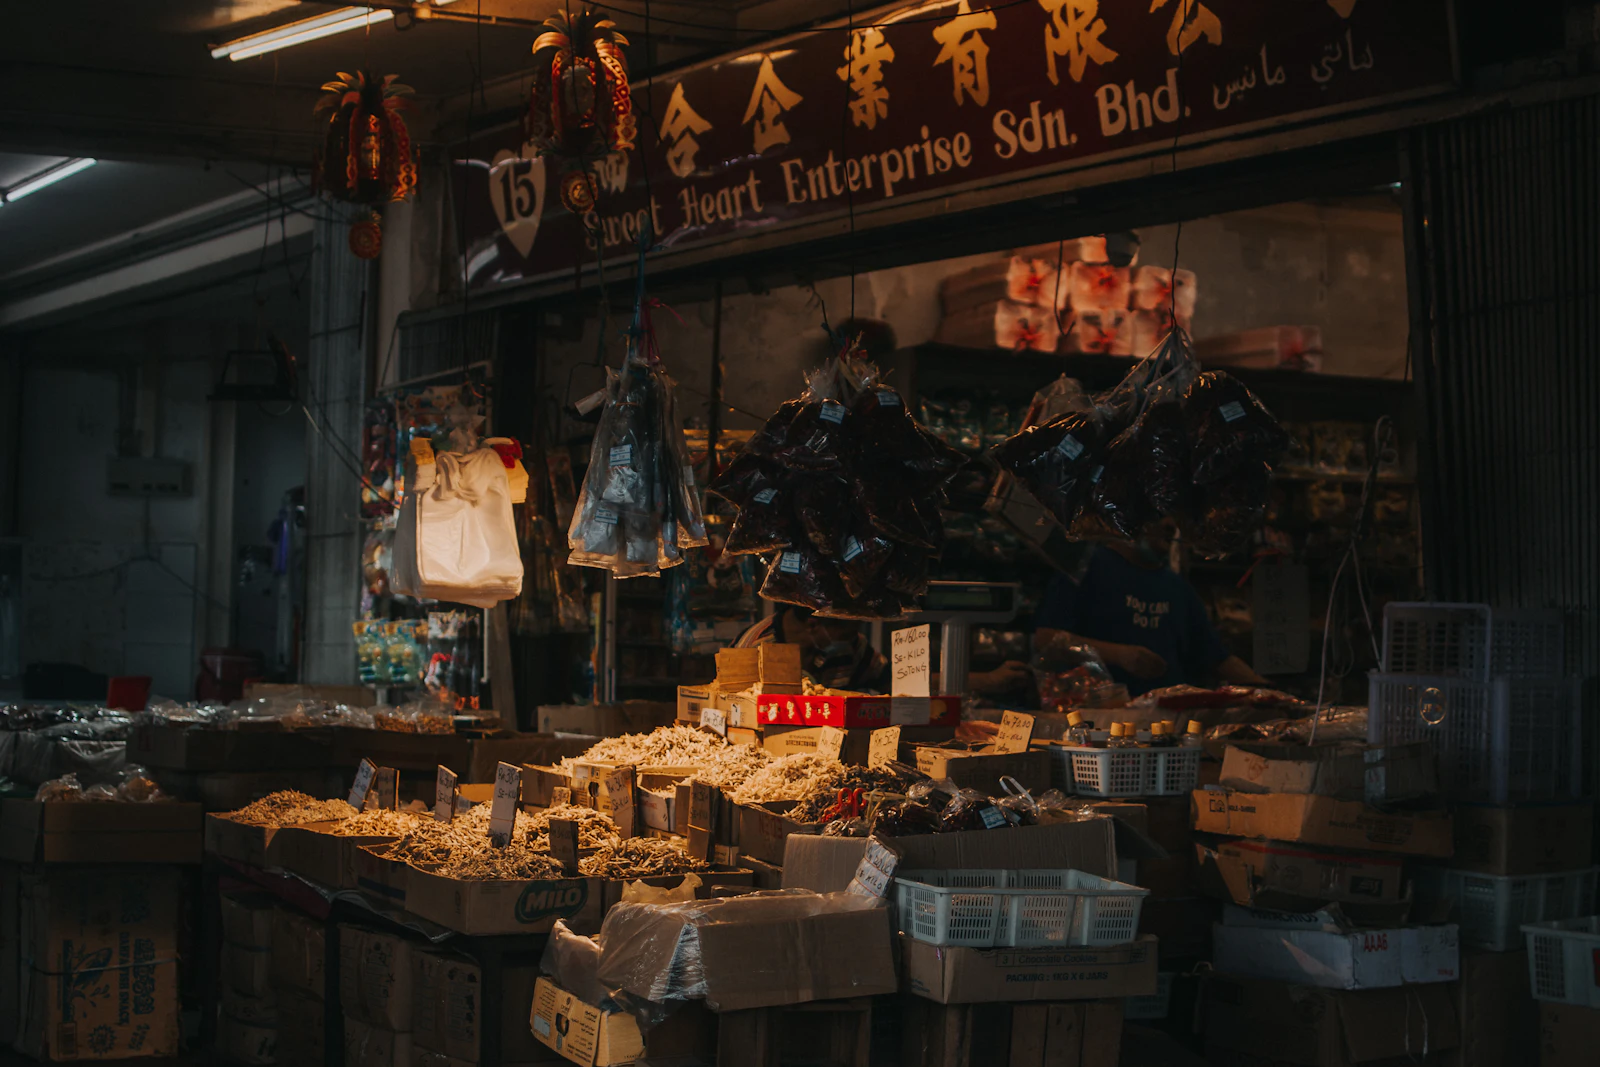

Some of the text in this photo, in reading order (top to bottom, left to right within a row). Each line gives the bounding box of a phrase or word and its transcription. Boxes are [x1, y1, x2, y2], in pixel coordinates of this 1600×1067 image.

[680, 170, 765, 228] Heart
[780, 124, 973, 205] Enterprise
[991, 99, 1079, 159] Sdn.
[1095, 67, 1192, 137] Bhd.
[499, 162, 537, 223] 15
[1125, 594, 1170, 614] YOU CAN
[1132, 612, 1161, 629] DO IT
[525, 887, 582, 914] MILO
[1063, 953, 1099, 963] Cookies
[1005, 973, 1045, 983] PACKING
[1085, 971, 1109, 981] JARS
[118, 991, 130, 1025] SNACK
